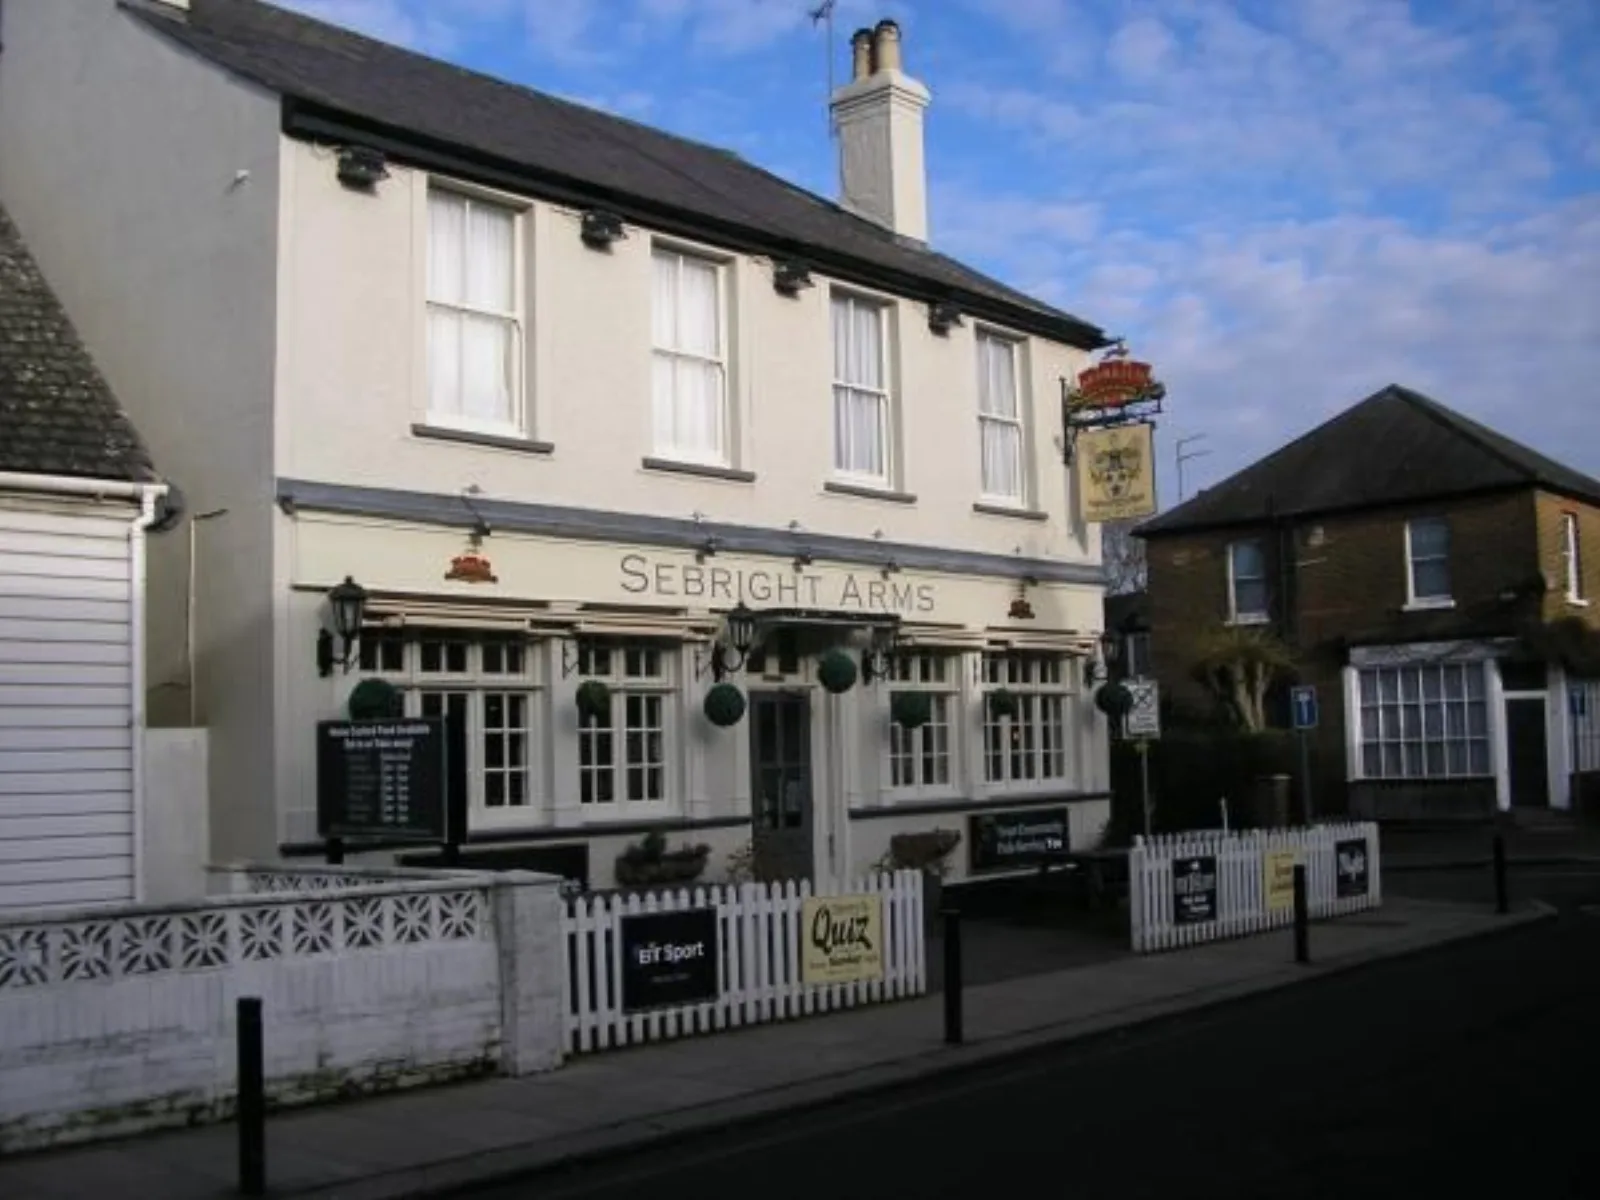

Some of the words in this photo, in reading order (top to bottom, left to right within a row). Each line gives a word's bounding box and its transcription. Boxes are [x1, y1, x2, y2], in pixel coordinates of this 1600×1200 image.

[620, 554, 823, 605] SEBRIGHT
[839, 573, 936, 613] ARMS
[663, 940, 705, 964] Sport
[813, 905, 872, 955] Quiz
